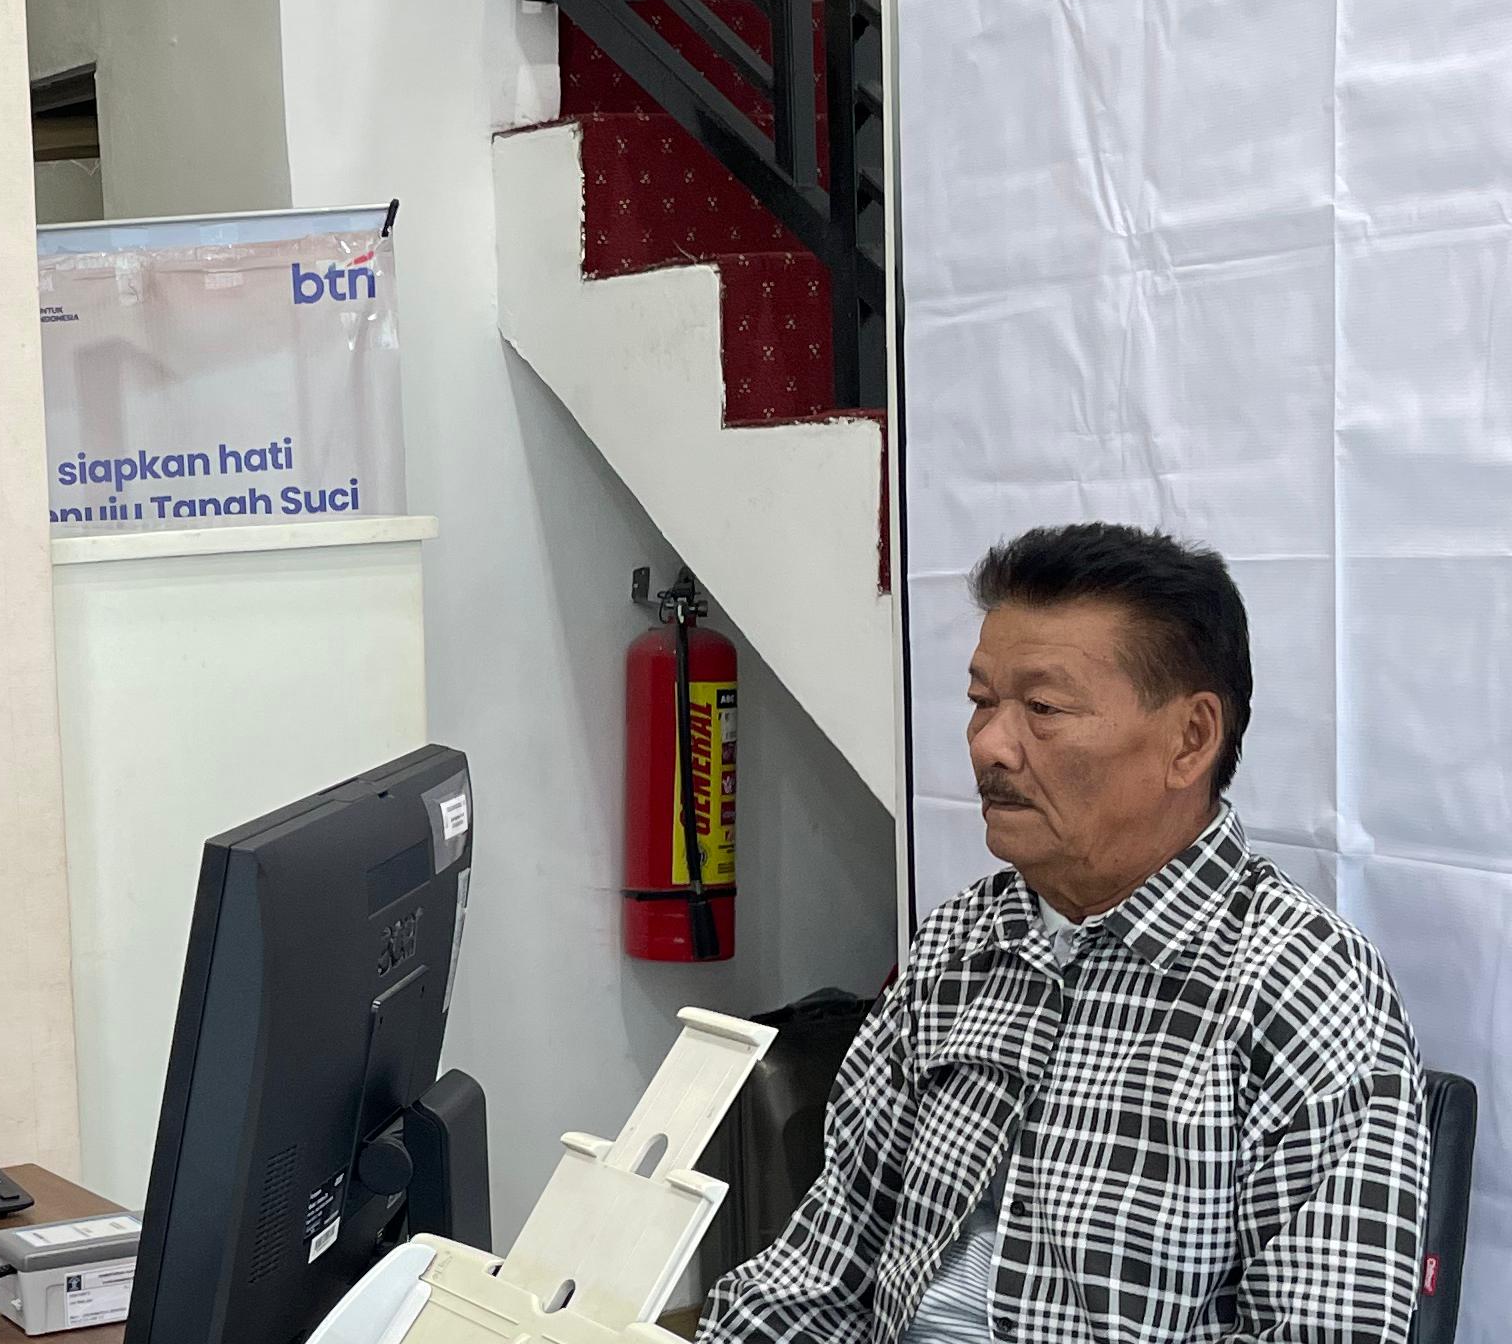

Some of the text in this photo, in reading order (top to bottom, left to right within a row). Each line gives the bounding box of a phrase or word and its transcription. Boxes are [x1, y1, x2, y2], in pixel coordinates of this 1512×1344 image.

[291, 258, 376, 304] btn
[58, 437, 294, 492] siapkan hati
[150, 487, 272, 521] Tanah
[281, 477, 360, 516] Suci
